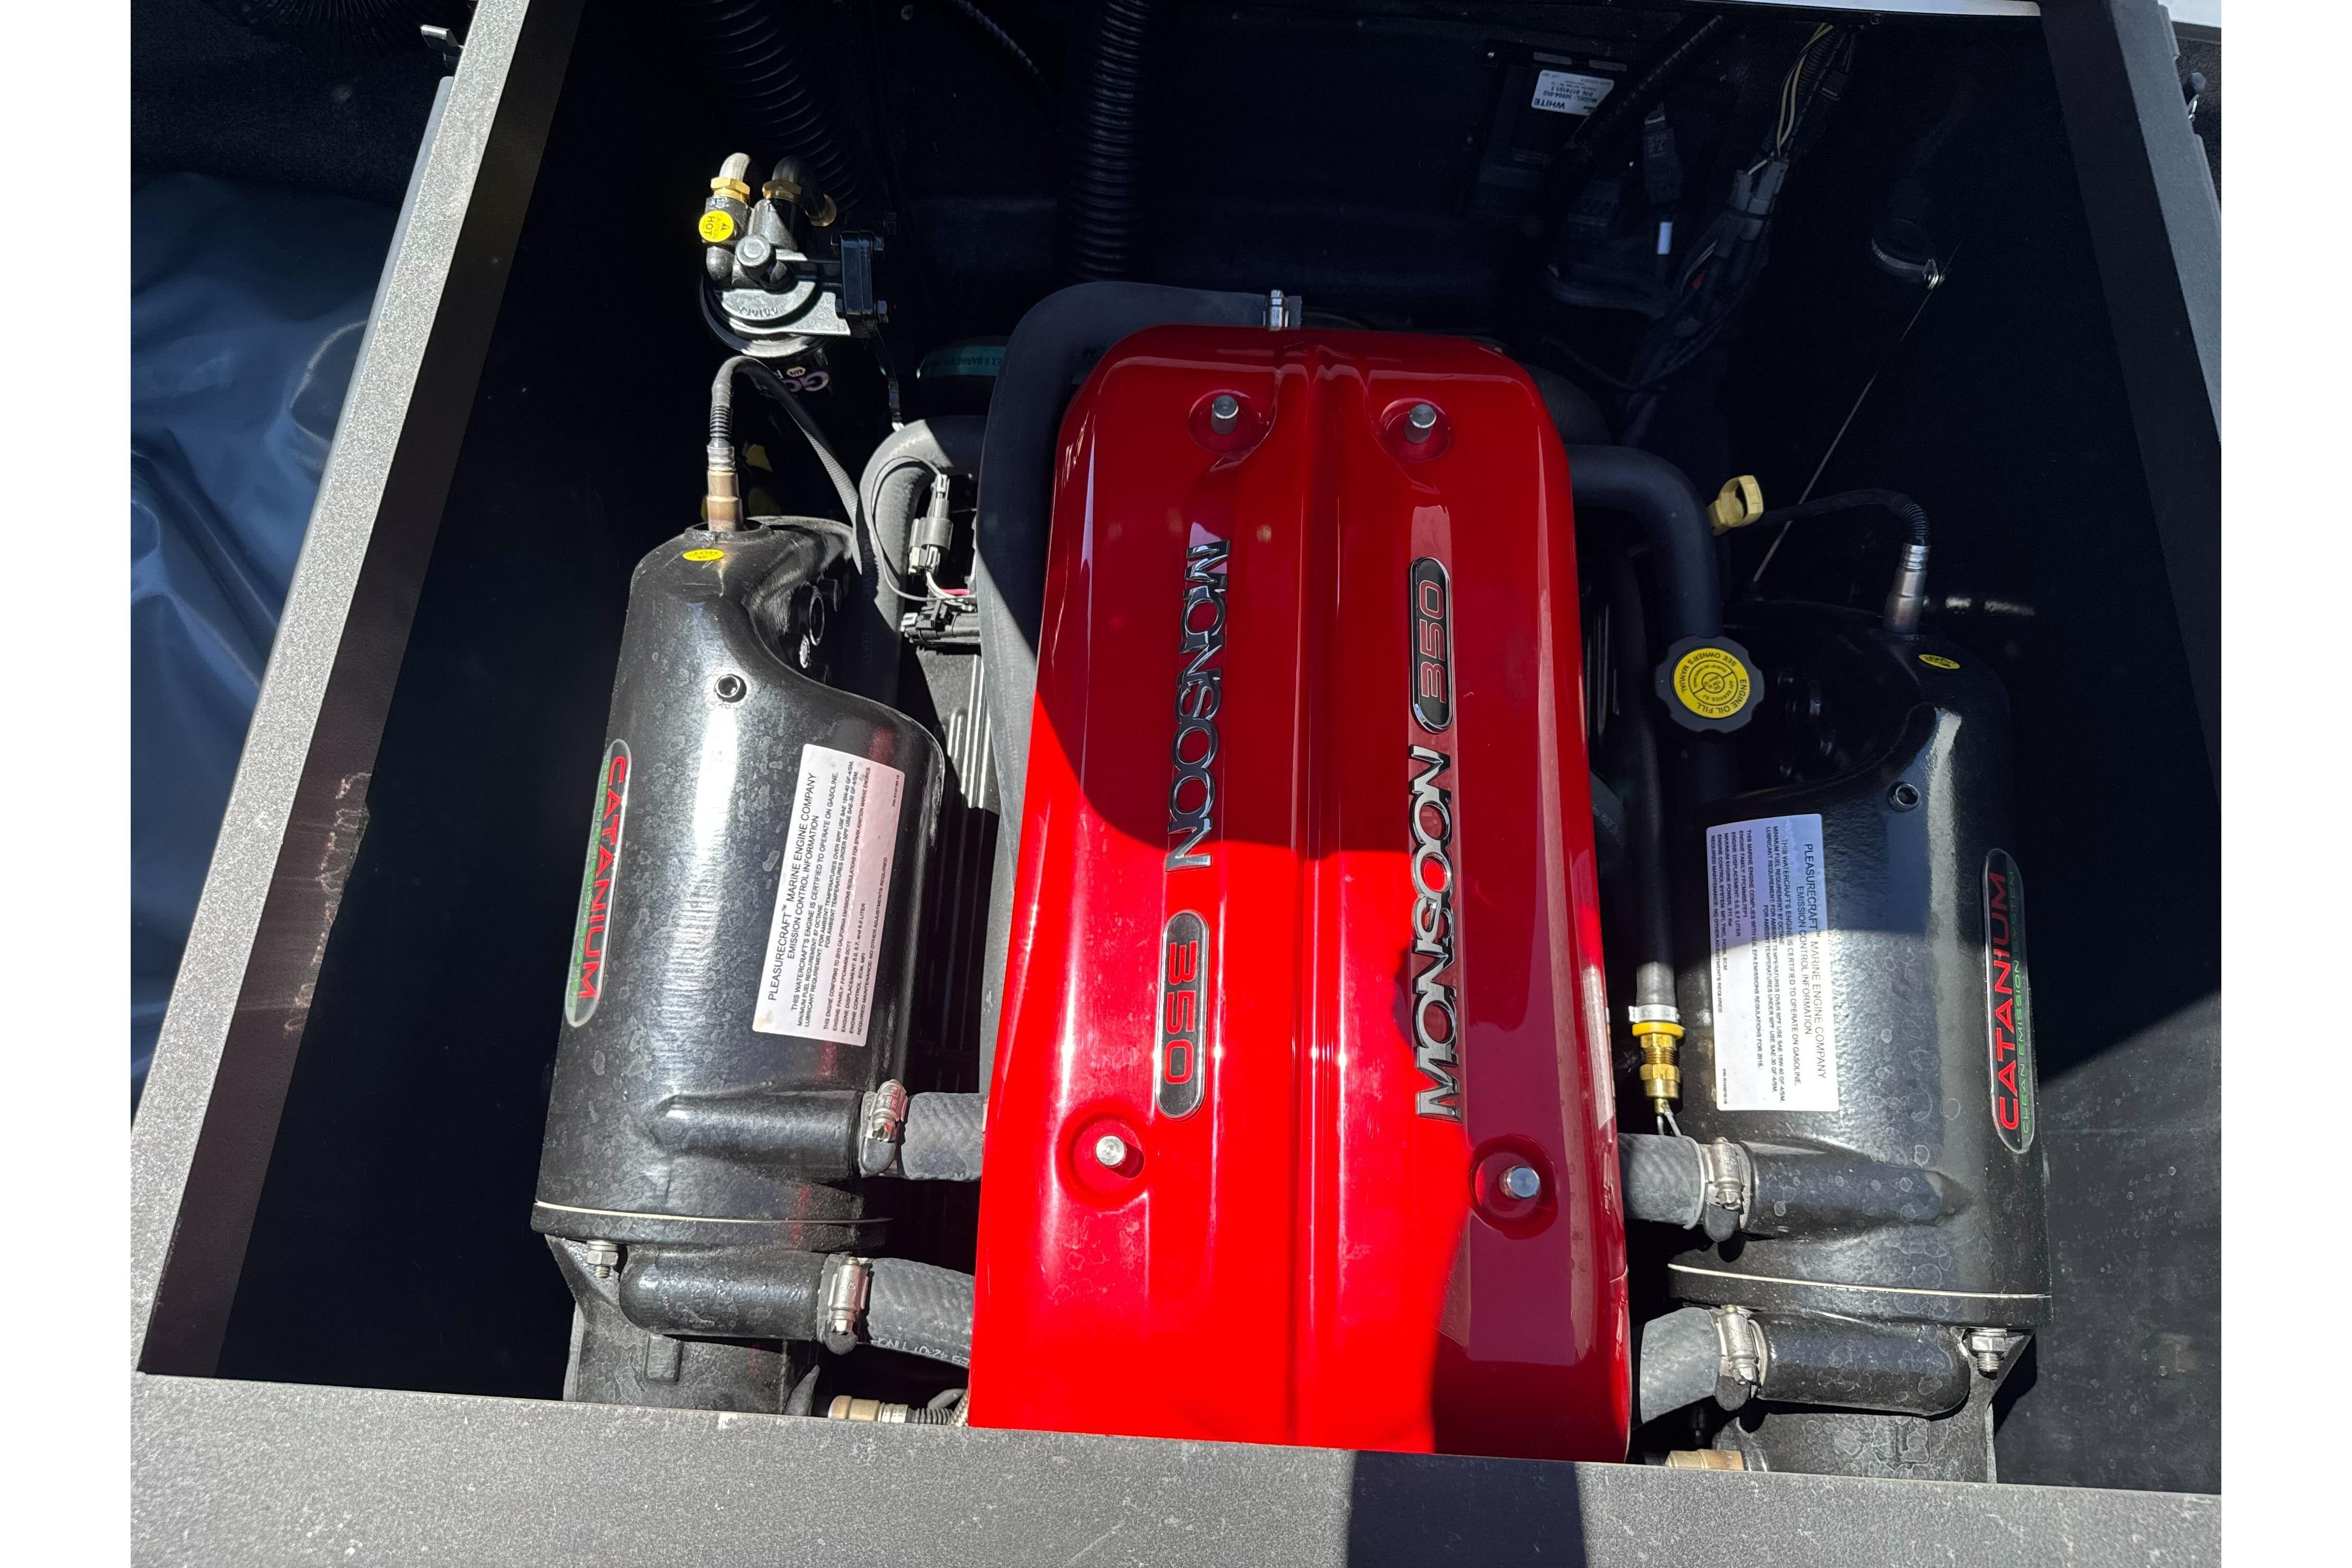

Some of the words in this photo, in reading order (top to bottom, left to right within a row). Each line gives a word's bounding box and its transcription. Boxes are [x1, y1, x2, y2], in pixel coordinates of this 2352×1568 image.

[1535, 99, 1565, 109] WHITE
[704, 216, 716, 236] HOT
[712, 214, 723, 239] CAUTION
[959, 356, 983, 366] MARINE
[1419, 580, 1447, 704] 350
[1687, 652, 1720, 665] OWNER'S
[1723, 655, 1737, 667] SEE
[1679, 665, 1689, 693] MANUAL
[1712, 690, 1732, 702] SERVICE
[1730, 679, 1747, 709] ENGINE
[1165, 539, 1230, 872] MONSOON
[1697, 702, 1713, 714] FILL
[1716, 705, 1730, 714] OIL
[824, 807, 832, 819] ON
[785, 862, 801, 902] MARINE
[793, 822, 807, 861] ENGINE
[800, 771, 817, 821] COMPANY
[802, 814, 819, 873] INFORMATION
[818, 819, 830, 852] OPERATE
[578, 755, 627, 998] CATANIUM
[583, 828, 602, 920] EMISSION
[817, 852, 824, 863] TO
[794, 873, 809, 916] CONTROL
[810, 863, 822, 901] CERTIFIED
[1782, 855, 1791, 909] WATERCRAFT'S
[804, 909, 815, 937] ENGINE
[808, 901, 816, 909] IS
[1796, 885, 1806, 928] EMISSION
[2008, 872, 2019, 957] SYSTEM
[787, 916, 802, 960] EMISSION
[1408, 744, 1462, 1122] MONSOON
[1798, 928, 1809, 972] CONTROL
[794, 937, 810, 993] WATERCRAFT'S
[1786, 947, 1795, 985] CERTIFIED
[1809, 941, 1821, 980] MARINE
[790, 993, 800, 1012] THIS
[1788, 987, 1796, 997] TO
[1801, 974, 1812, 1035] INFORMATION
[1812, 984, 1823, 1023] ENGINE
[1989, 872, 2019, 1129] CATANIUM
[2011, 959, 2024, 1055] EMISSION
[1163, 940, 1198, 1085] 350
[1789, 998, 1798, 1032] OPERATE
[1791, 1033, 1798, 1045] ON
[1814, 1026, 1826, 1080] COMPANY
[2017, 1057, 2029, 1134] CLEAN
